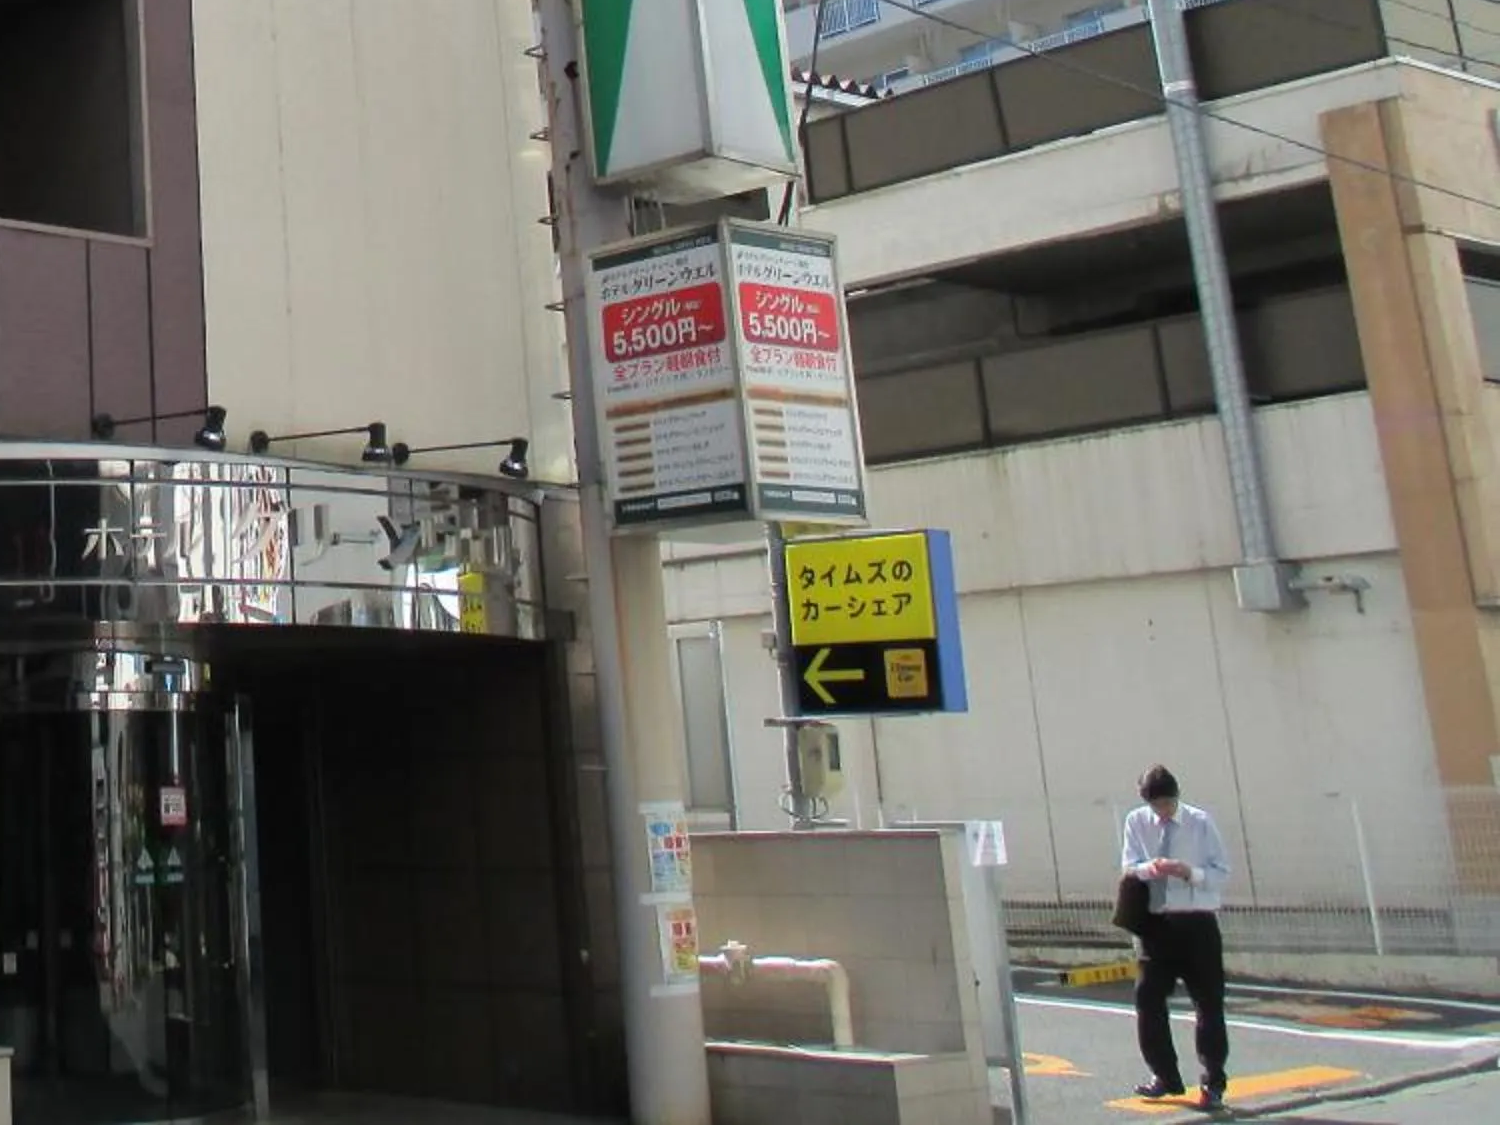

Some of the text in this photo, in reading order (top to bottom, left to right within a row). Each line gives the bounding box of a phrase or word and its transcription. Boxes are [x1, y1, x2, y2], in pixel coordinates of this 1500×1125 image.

[621, 297, 681, 326] シングル
[755, 290, 805, 314] シングル
[800, 560, 913, 590] タイムズの
[802, 592, 912, 621] カーシェア
